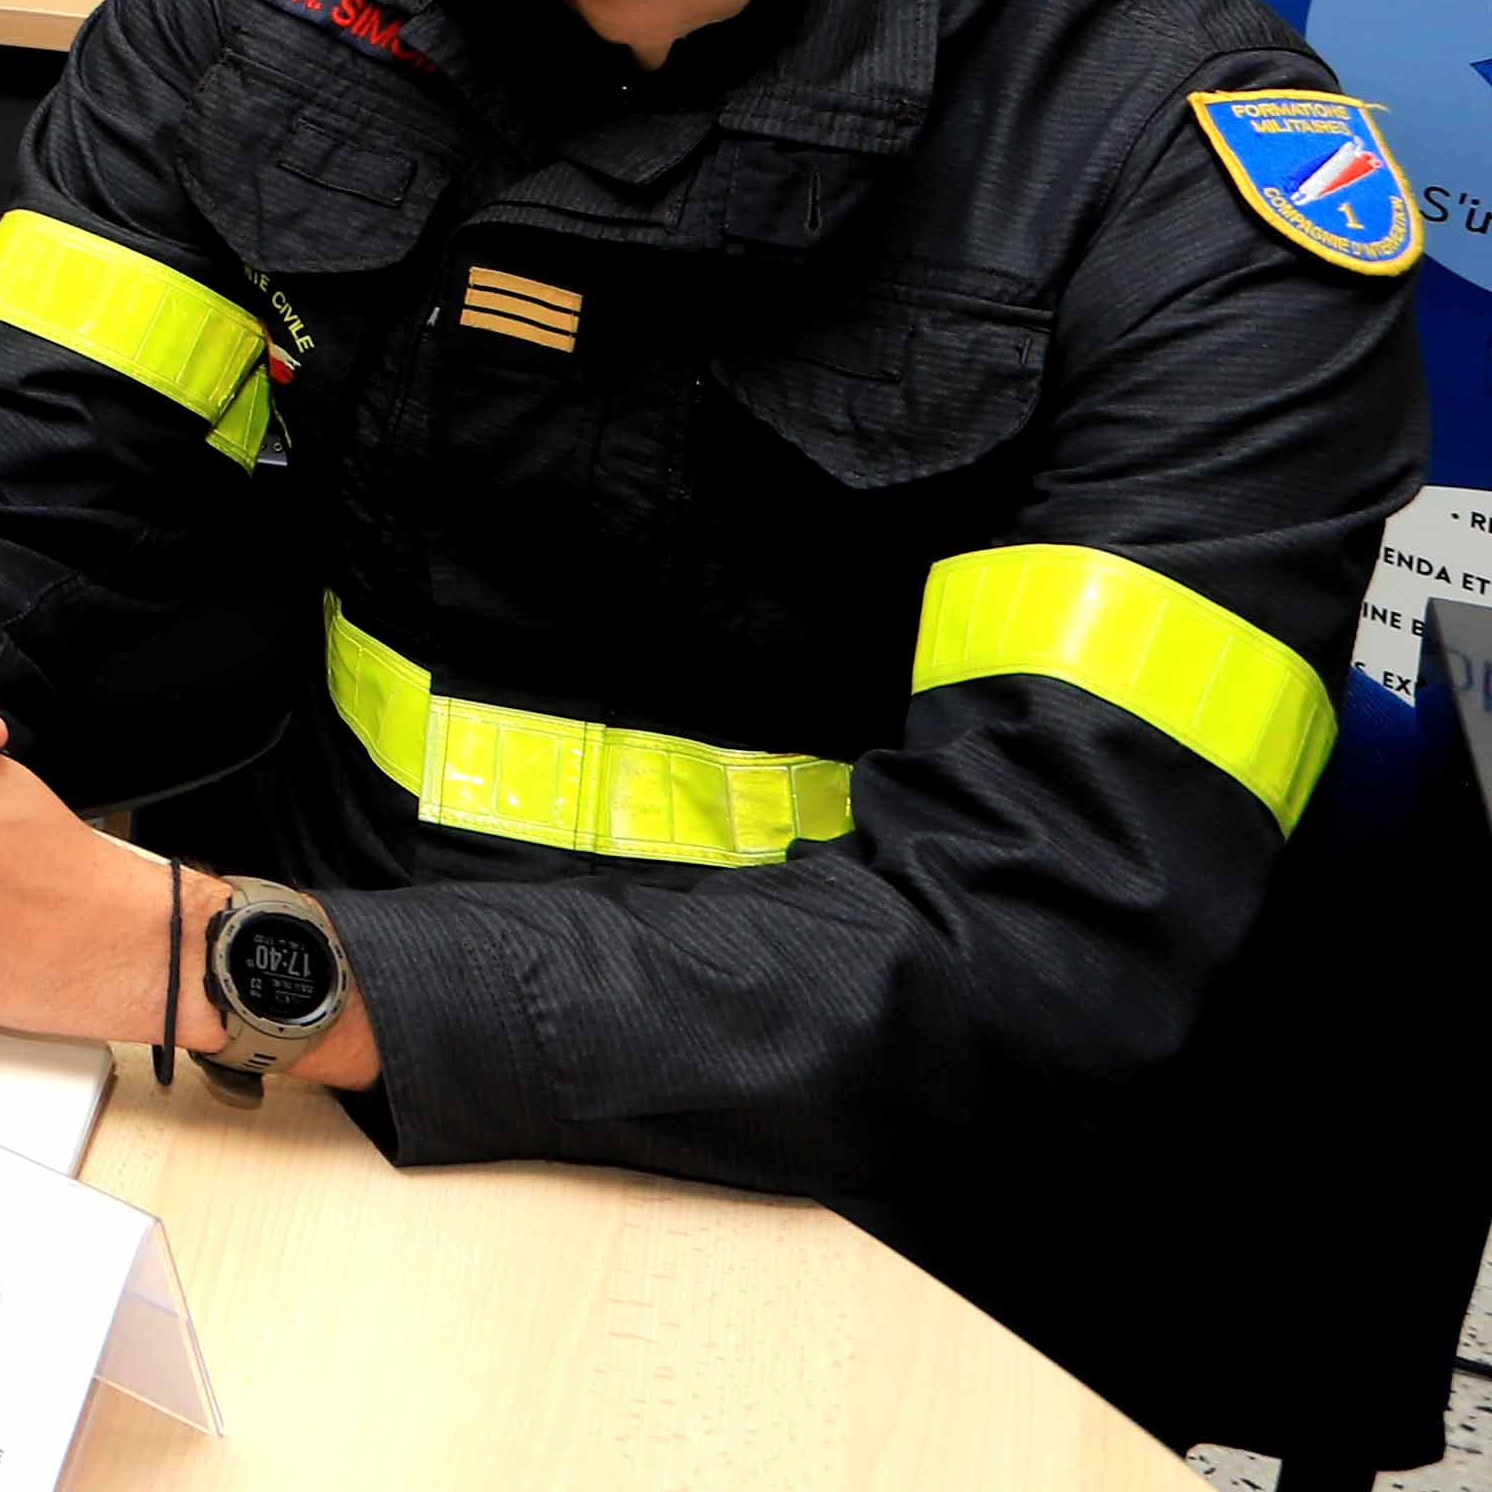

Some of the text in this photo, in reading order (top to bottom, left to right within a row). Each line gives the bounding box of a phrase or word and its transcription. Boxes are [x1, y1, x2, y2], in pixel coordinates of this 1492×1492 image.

[1231, 103, 1352, 121] FORMATIONS
[1249, 118, 1353, 137] MILITAIRES
[1263, 186, 1351, 251] COMPAGNIE
[1337, 202, 1364, 231] 1
[271, 291, 316, 354] CIVILE
[1461, 572, 1491, 596] ET
[255, 943, 312, 979] 17:40
